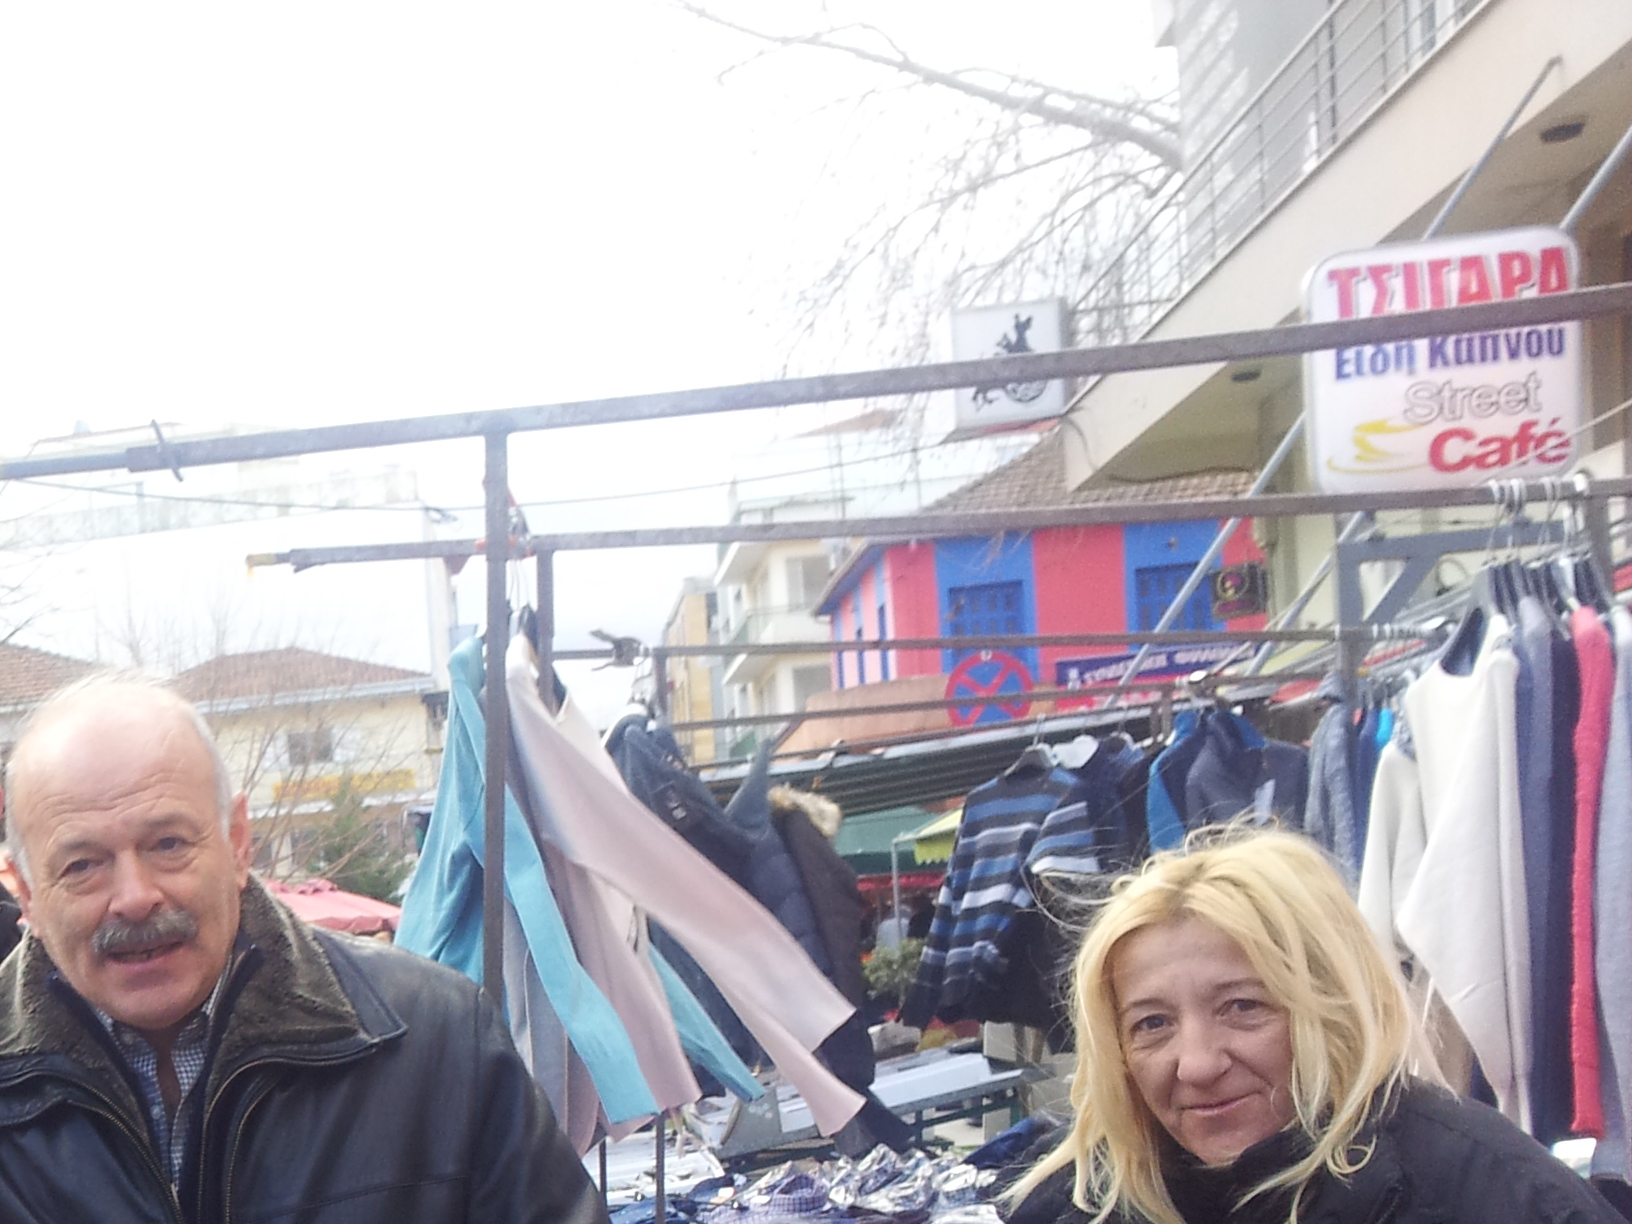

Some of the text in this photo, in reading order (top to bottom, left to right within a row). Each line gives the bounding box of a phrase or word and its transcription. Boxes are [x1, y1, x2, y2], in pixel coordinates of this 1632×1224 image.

[1327, 246, 1568, 320] ΤΣΙΓΑΡΑ
[1403, 370, 1543, 425] Street
[1428, 417, 1572, 474] Café
